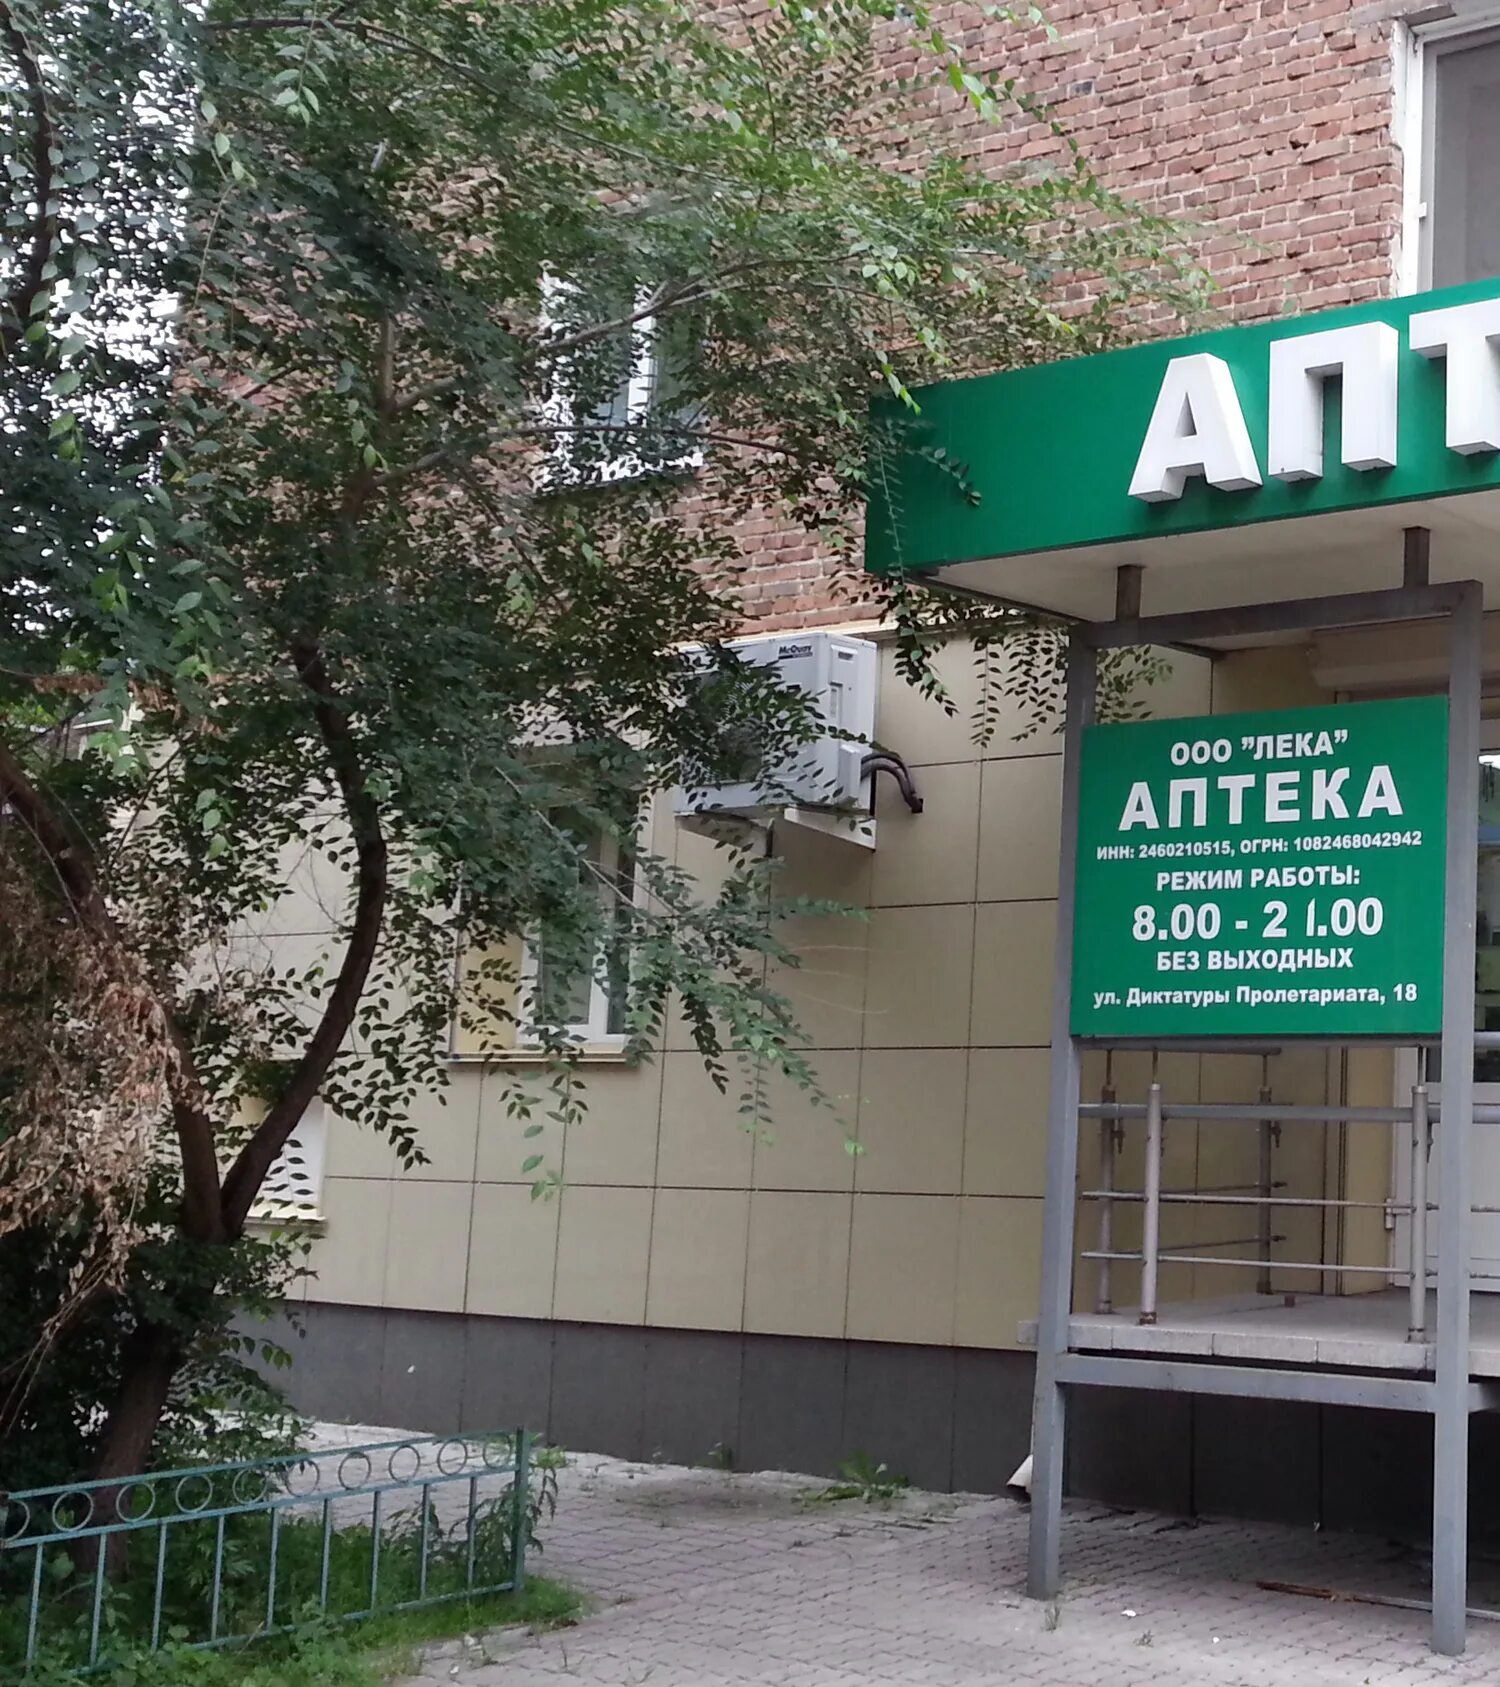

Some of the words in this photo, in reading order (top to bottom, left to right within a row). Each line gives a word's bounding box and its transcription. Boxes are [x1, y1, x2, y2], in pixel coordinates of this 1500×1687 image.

[1170, 739, 1232, 766] ООО
[1241, 729, 1348, 760] "ЛЕКА"
[1118, 765, 1404, 831] АПТЕКА
[1096, 846, 1135, 860] ИНН:
[1138, 840, 1236, 859] 2460210515,
[1240, 839, 1289, 854] ОГРН:
[1293, 831, 1422, 851] 1082468042942
[1156, 869, 1243, 891] РЕЖИМ
[1250, 865, 1360, 889] РАБОТЫ:
[1132, 903, 1221, 941] 8.00
[1157, 951, 1200, 971] БЕЗ
[1207, 947, 1354, 973] ВЫХОДНЫХ
[1093, 993, 1121, 1009] ул.
[1126, 987, 1230, 1009] Диктатуры
[1236, 986, 1386, 1008] Пролетариата,
[1393, 984, 1418, 1002] 18
